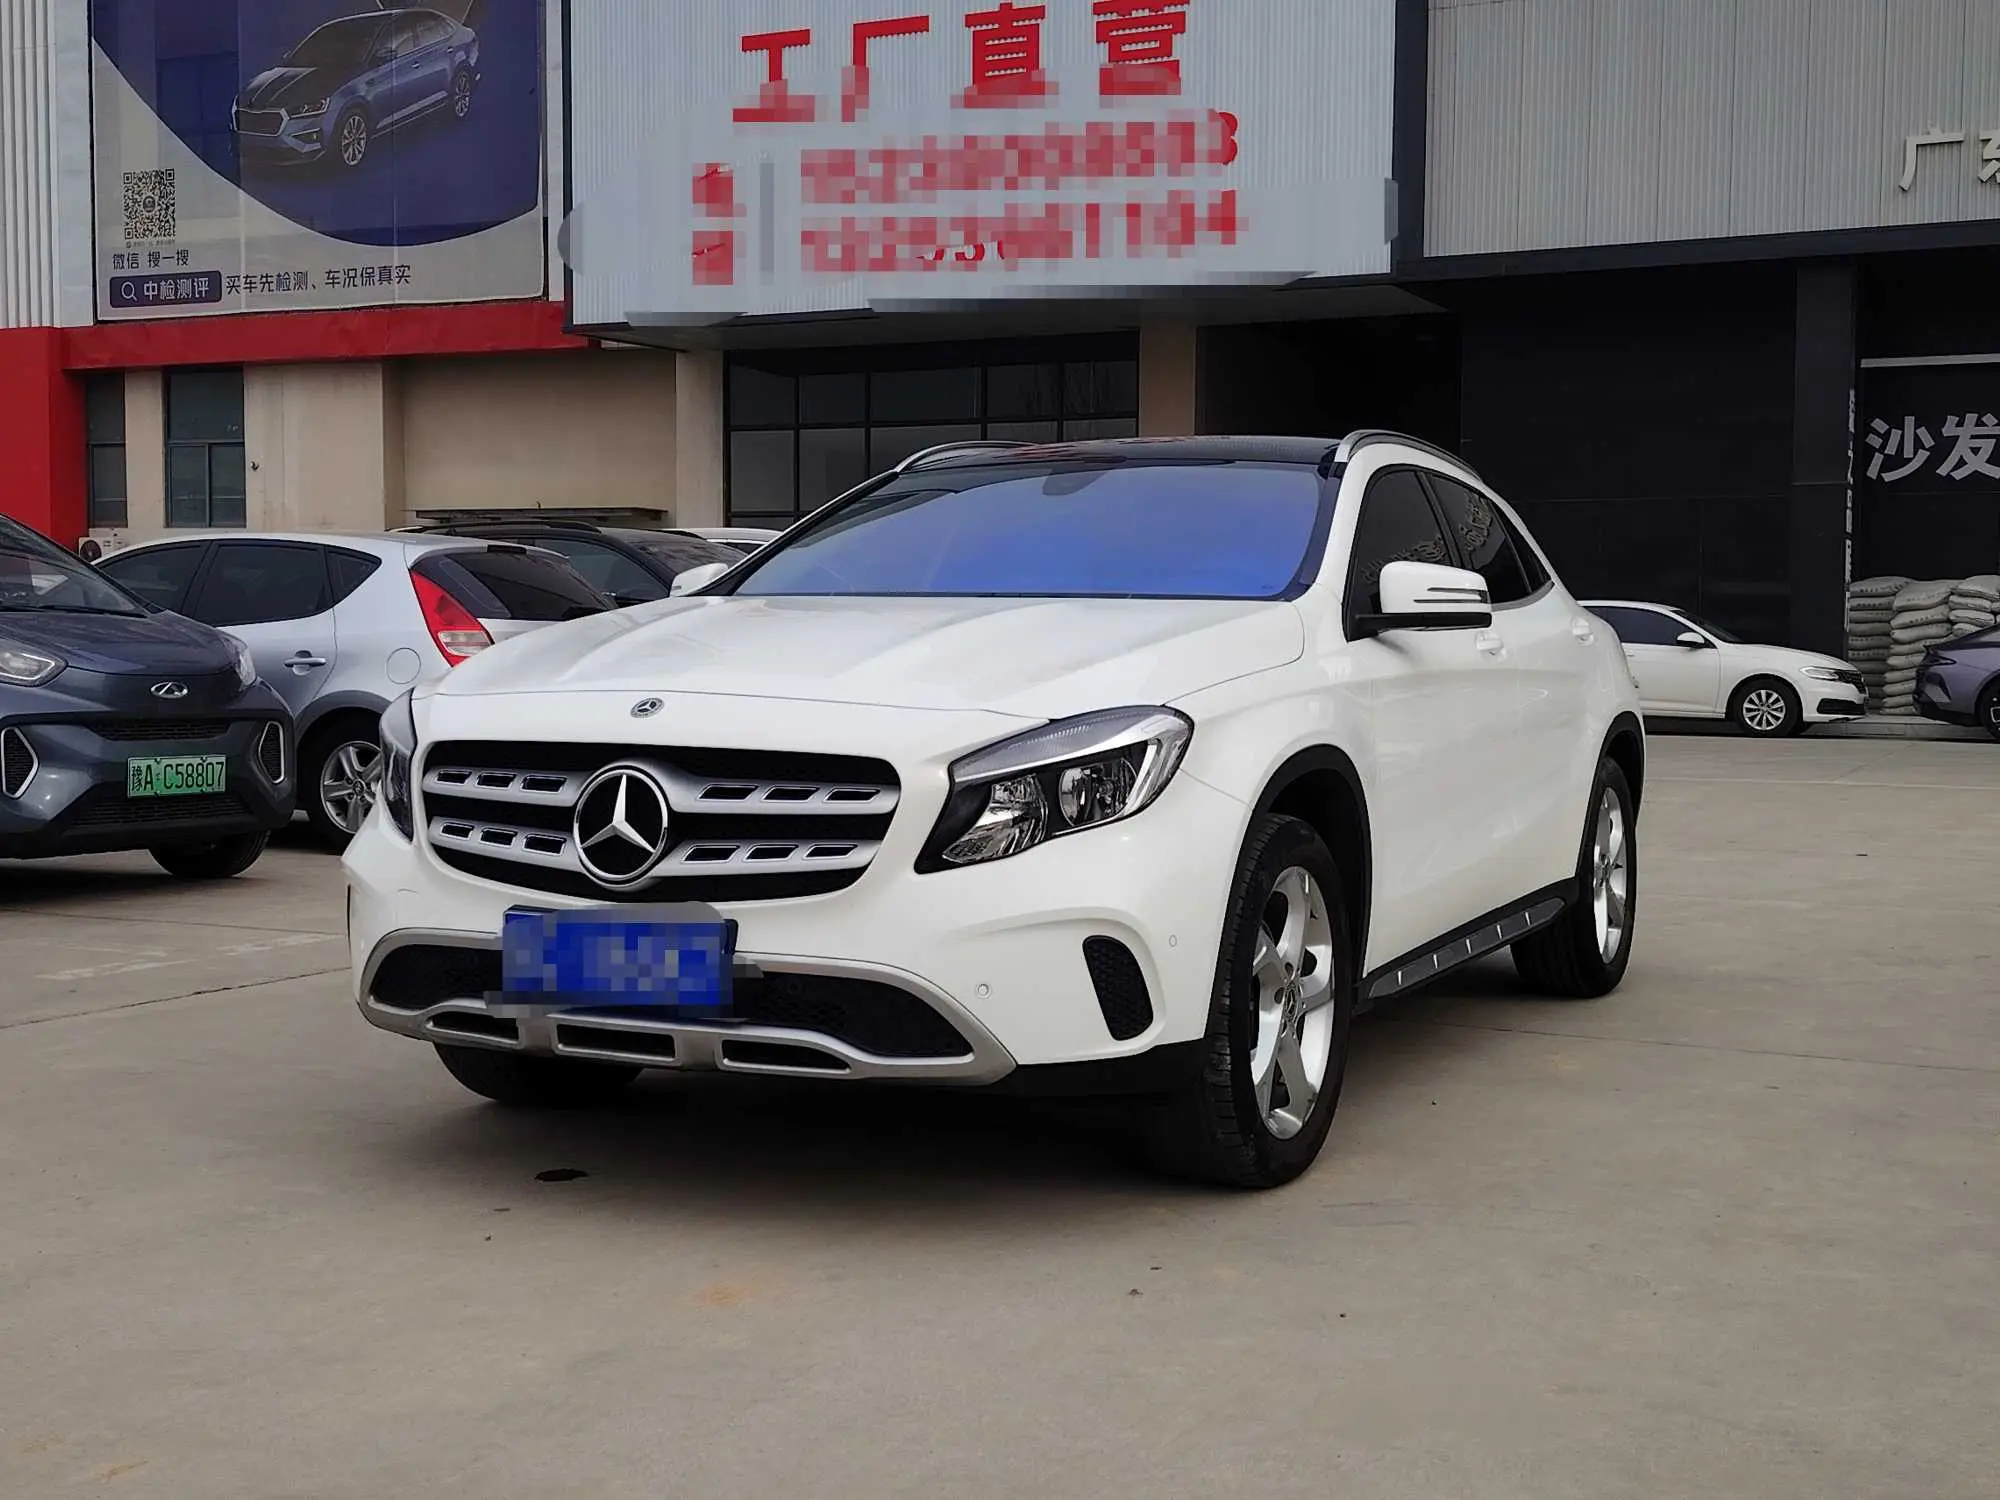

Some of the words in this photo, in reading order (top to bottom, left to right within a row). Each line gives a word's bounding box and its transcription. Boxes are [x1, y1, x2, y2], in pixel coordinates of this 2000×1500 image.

[112, 253, 140, 270] 微信
[147, 250, 189, 268] 搜一搜
[143, 278, 210, 301] 中检测评
[226, 264, 412, 295] 买车先检测、车况保真实
[1865, 413, 2000, 482] 沙发
